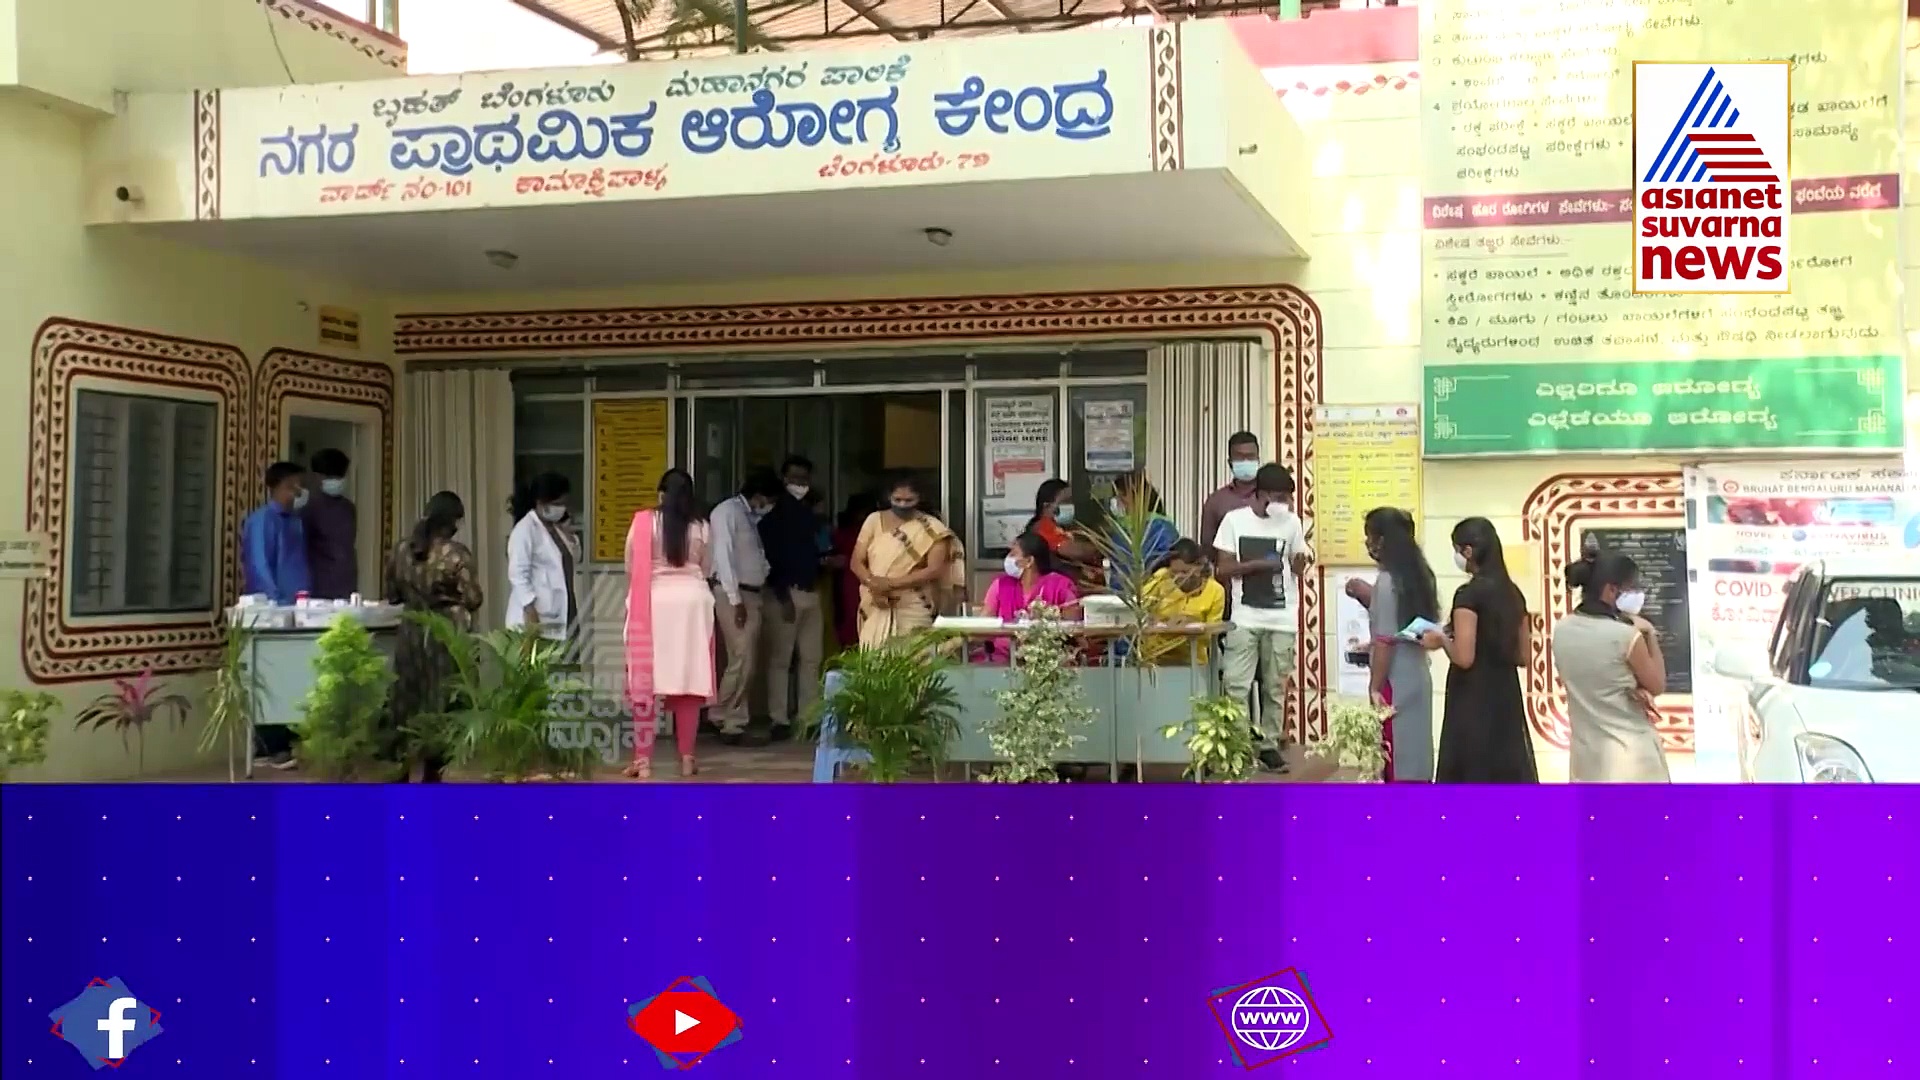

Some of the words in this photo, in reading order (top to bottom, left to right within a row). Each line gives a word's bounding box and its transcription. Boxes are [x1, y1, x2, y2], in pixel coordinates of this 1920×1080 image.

[373, 88, 463, 127] ಬೃಹತ್
[481, 80, 615, 110] ಬೆಂಗಳೂರು
[665, 61, 808, 98] ಮಹಾನಗರ
[820, 54, 911, 87] ಪಾಲಿಕೆ
[259, 123, 359, 177] ನಗರ
[390, 101, 657, 176] ಪ್ರಾಥಮಿಕ
[681, 87, 901, 154] ಆರೋಗ್ಯ
[934, 69, 1114, 139] ಕೇಂದ್ರ
[1652, 375, 1761, 400] ಆರೋಗ್ಯ
[1667, 406, 1778, 431] ಆರೋಗ್ಯ
[1743, 484, 1784, 494] BRUHAT
[1714, 580, 1779, 597] COVID-
